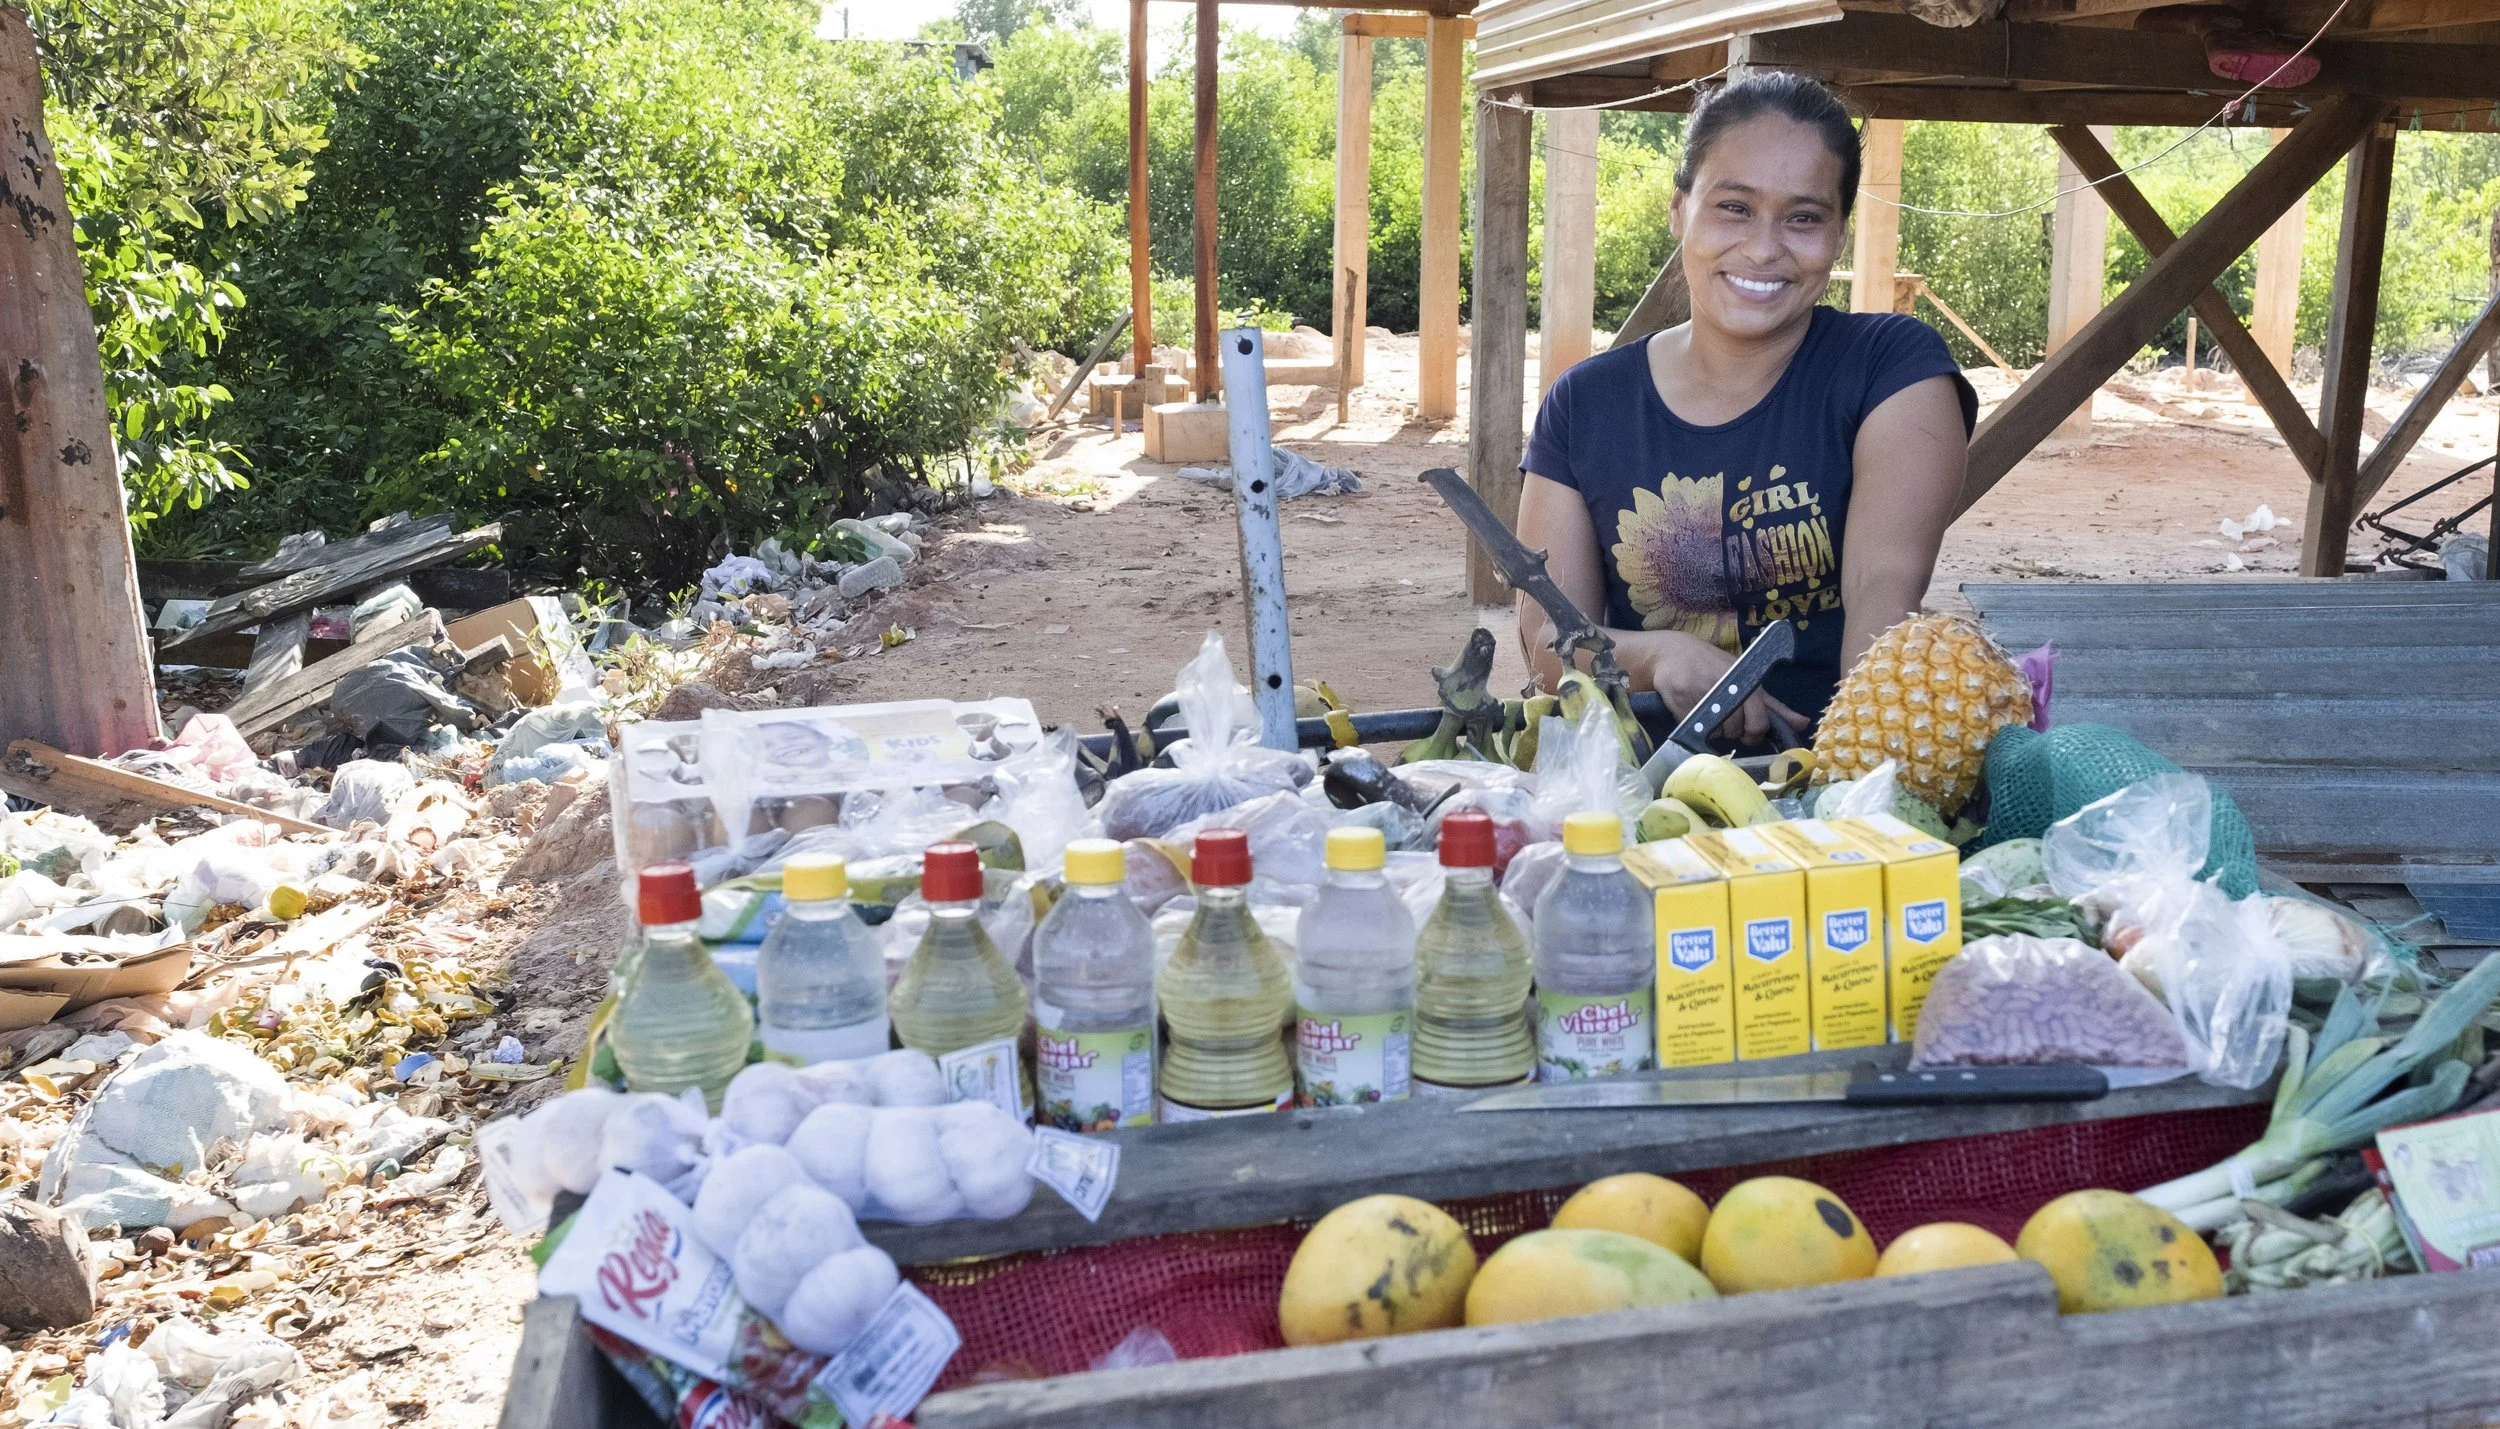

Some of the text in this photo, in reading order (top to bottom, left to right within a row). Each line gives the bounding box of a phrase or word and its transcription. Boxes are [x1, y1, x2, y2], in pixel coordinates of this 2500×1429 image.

[1729, 481, 1819, 523] GIRL
[1726, 515, 1836, 594] FASHION
[1745, 584, 1841, 626] LOVE
[1828, 915, 1864, 928] Better
[1907, 906, 1943, 920] Better
[1749, 924, 1787, 937] Better
[1829, 926, 1865, 944] Valu
[1909, 917, 1944, 936] Valu
[1673, 933, 1712, 947] Better
[1751, 935, 1787, 954] Valu
[1675, 944, 1711, 963] Valu
[1559, 1006, 1642, 1034] Vinegar
[1580, 999, 1628, 1022] Chef
